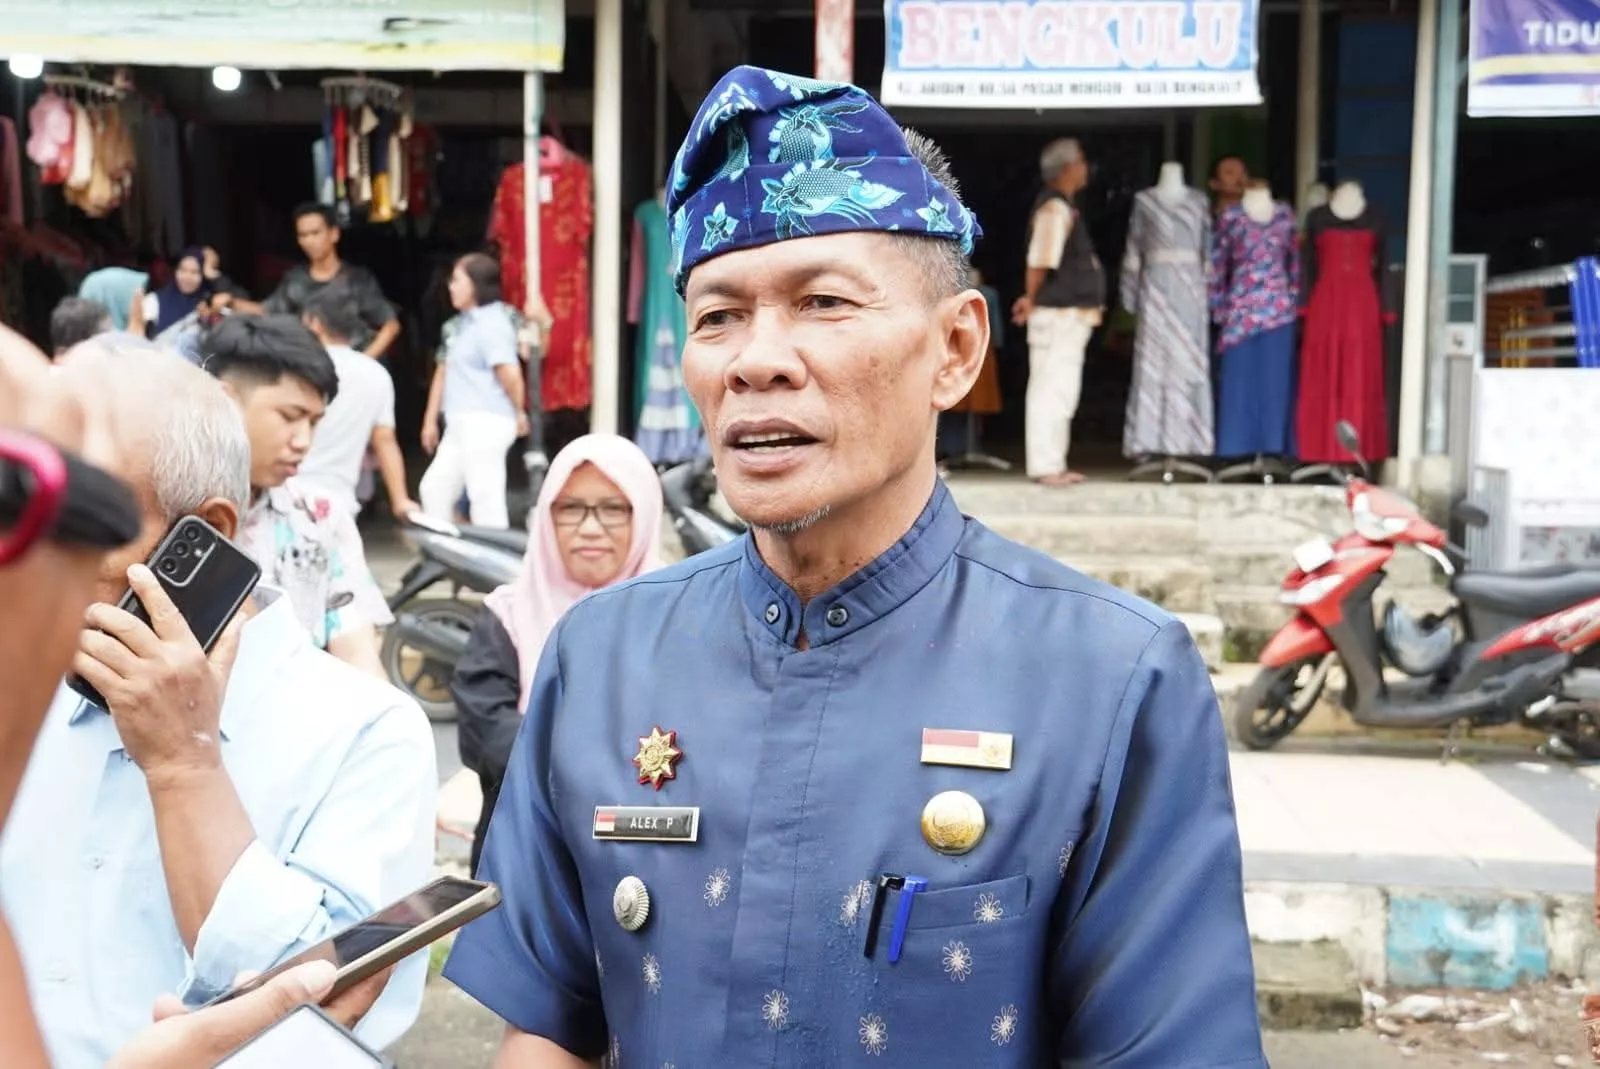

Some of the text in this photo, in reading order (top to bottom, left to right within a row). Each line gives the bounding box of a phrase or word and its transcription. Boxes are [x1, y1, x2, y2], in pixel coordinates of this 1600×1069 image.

[901, 2, 1240, 66] BENGKULU
[1523, 20, 1600, 46] TIDU
[630, 816, 674, 830] ALEX P
